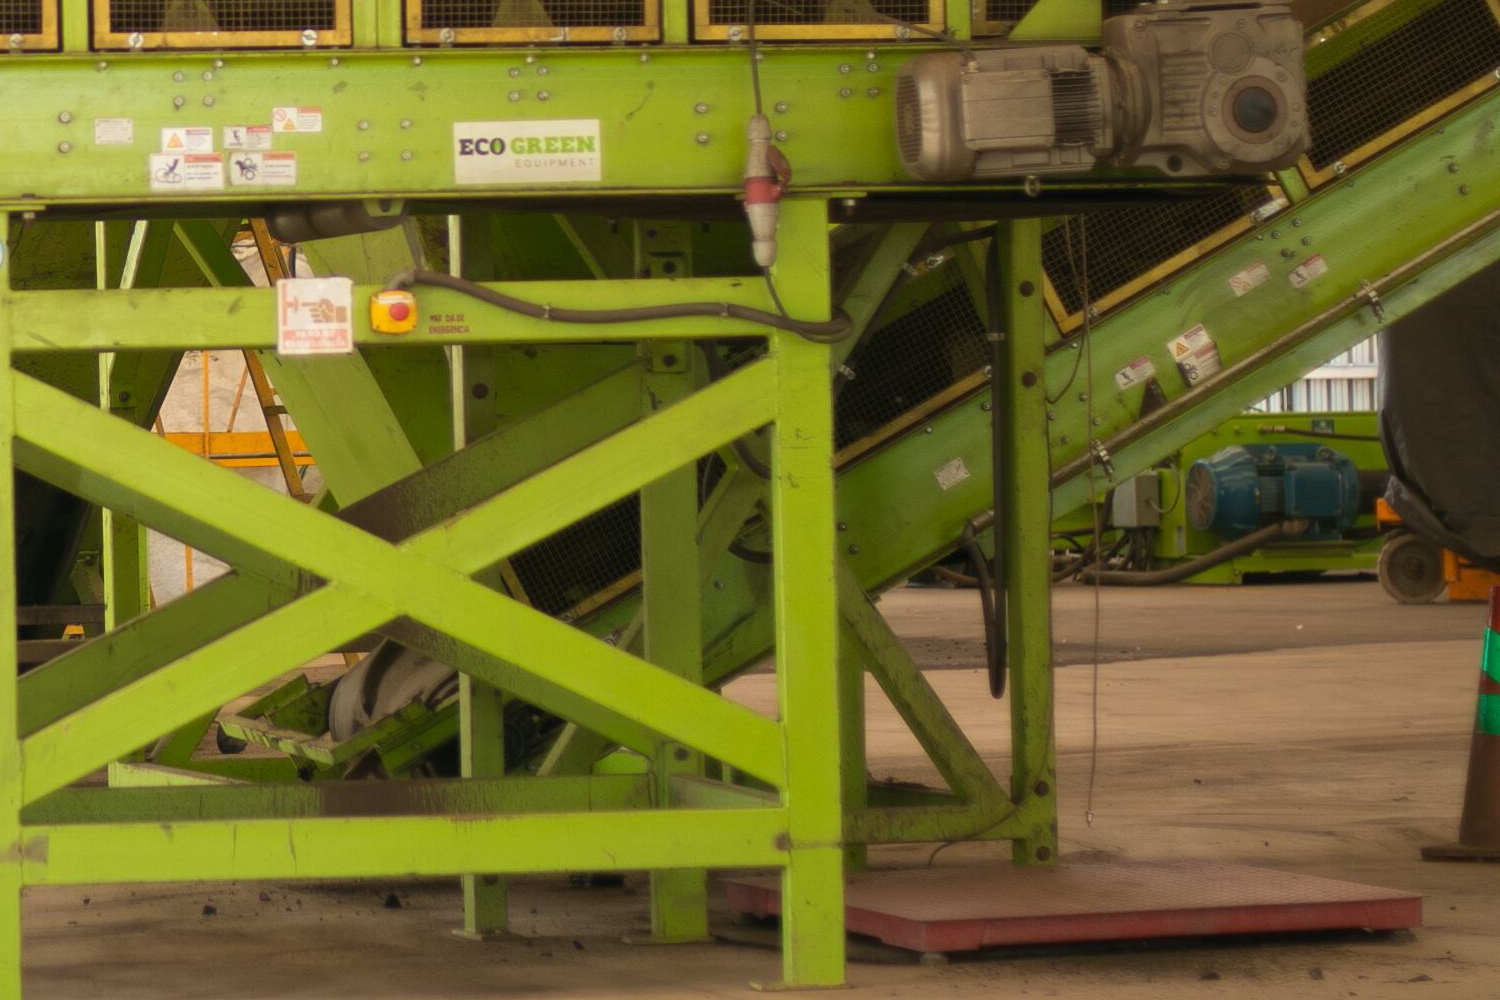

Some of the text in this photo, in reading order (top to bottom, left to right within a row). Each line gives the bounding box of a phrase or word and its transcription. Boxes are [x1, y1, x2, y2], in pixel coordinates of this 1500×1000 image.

[459, 135, 596, 156] ECO GREEN
[515, 157, 595, 168] EQUIPMENT
